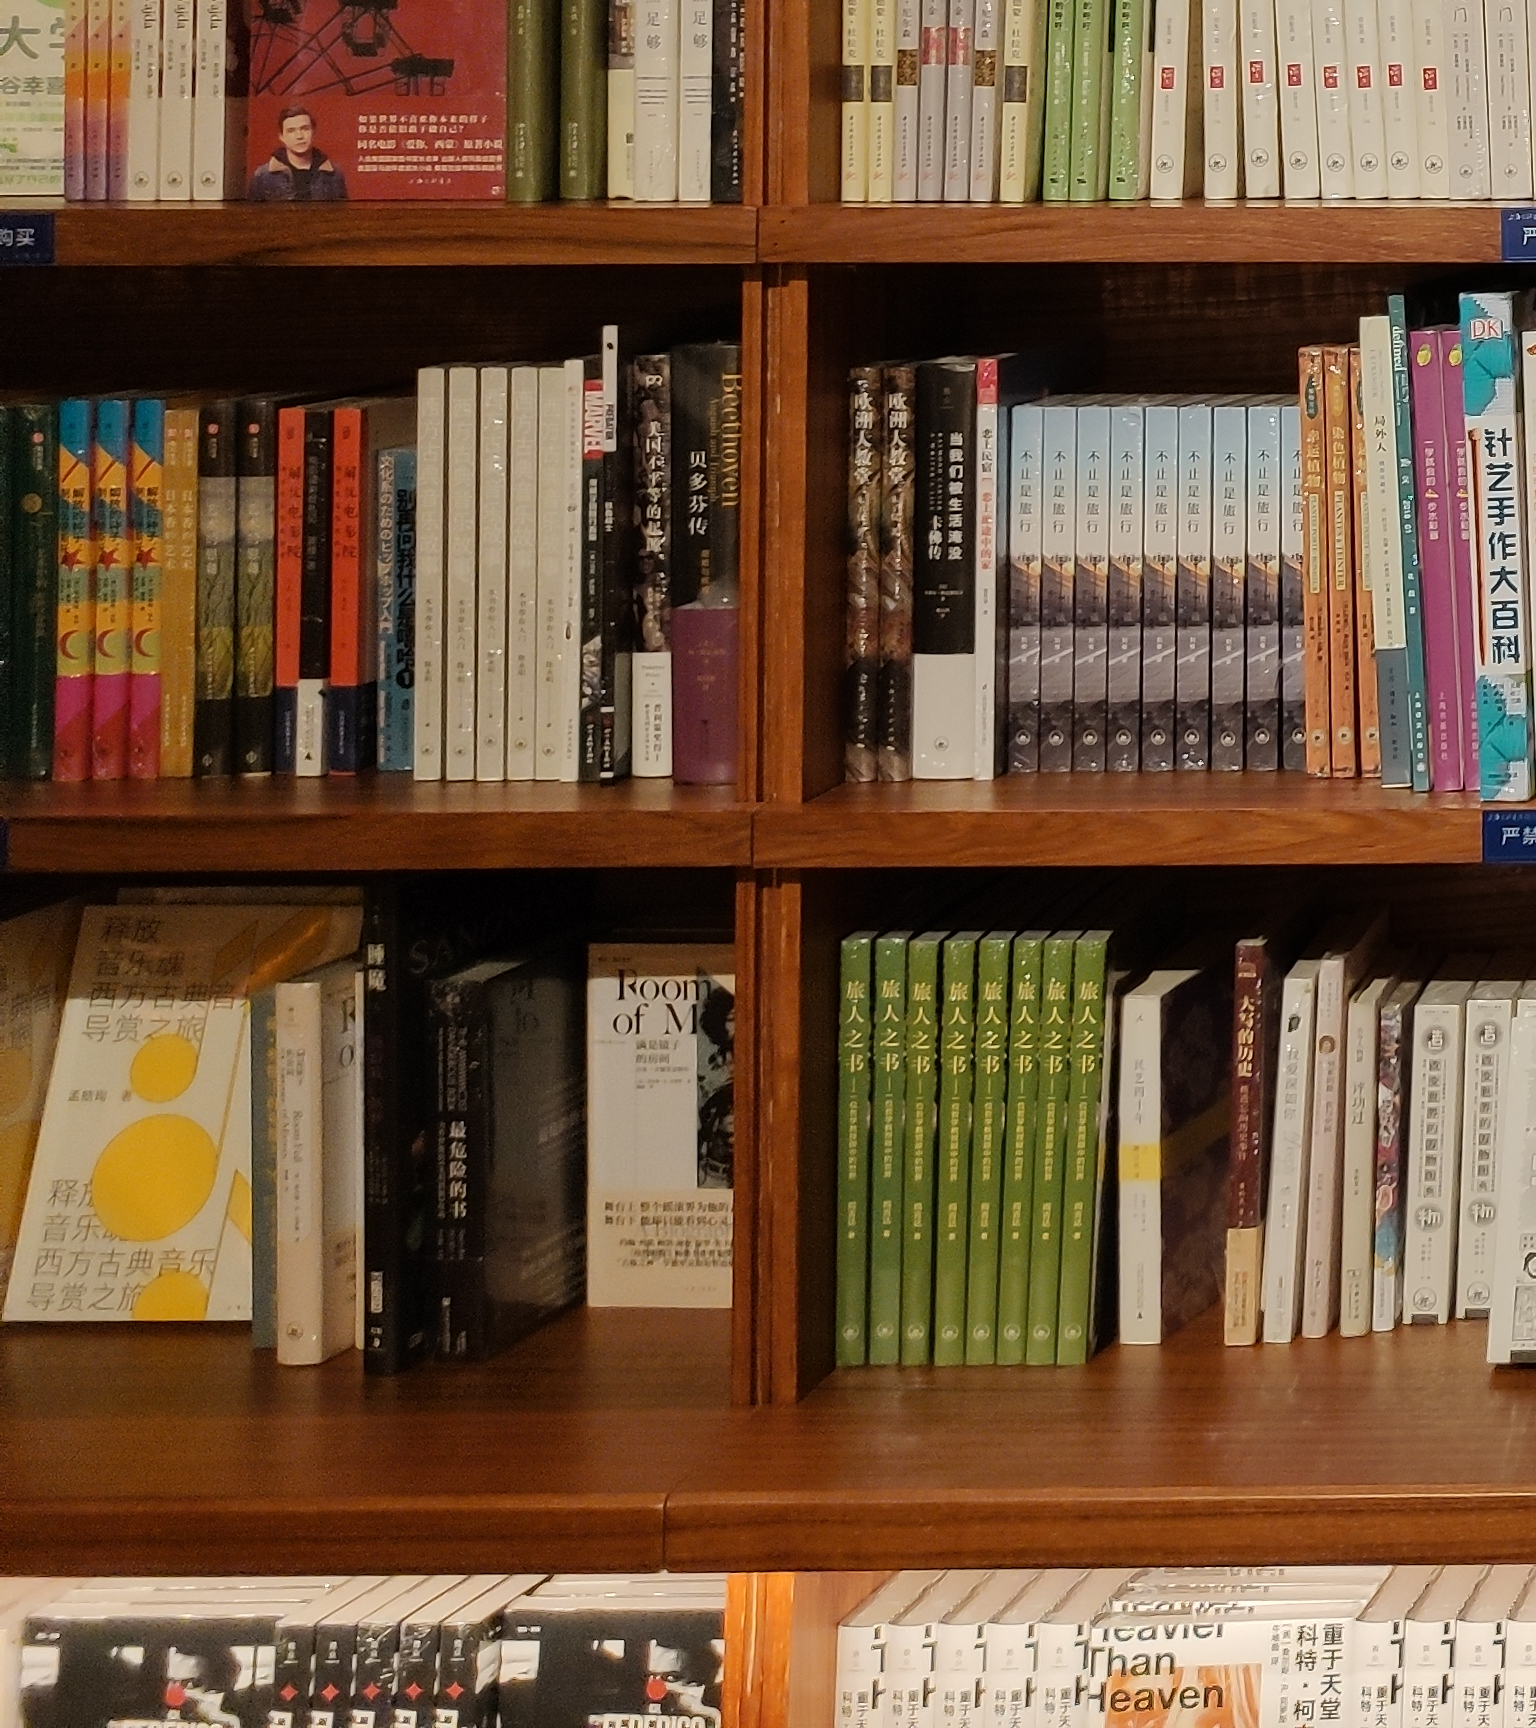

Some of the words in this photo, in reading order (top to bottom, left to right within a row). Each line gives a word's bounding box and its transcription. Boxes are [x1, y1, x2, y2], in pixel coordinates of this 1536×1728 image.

[1472, 319, 1502, 339] DK
[721, 371, 742, 508] Beethoven
[688, 451, 708, 536] 贝多芬传
[947, 431, 965, 561] 当我们被生活淹没
[1018, 449, 1033, 534] 不止是旅行
[1052, 449, 1066, 534] 不止是旅行
[1222, 451, 1237, 535] 不止是旅行
[1483, 427, 1521, 665] 针艺手作大百科
[616, 969, 713, 1003] Room
[844, 980, 866, 1075] 旅人之书
[910, 980, 932, 1075] 旅人之书
[981, 980, 1003, 1075] 旅人之书
[1236, 996, 1256, 1077] 大写的历史
[449, 1121, 468, 1220] 最危险的书
[34, 1247, 218, 1279] 西方古典音乐
[1088, 1648, 1177, 1679] Than
[1088, 1681, 1225, 1713] Heaven
[1322, 1623, 1343, 1721] 重于天堂
